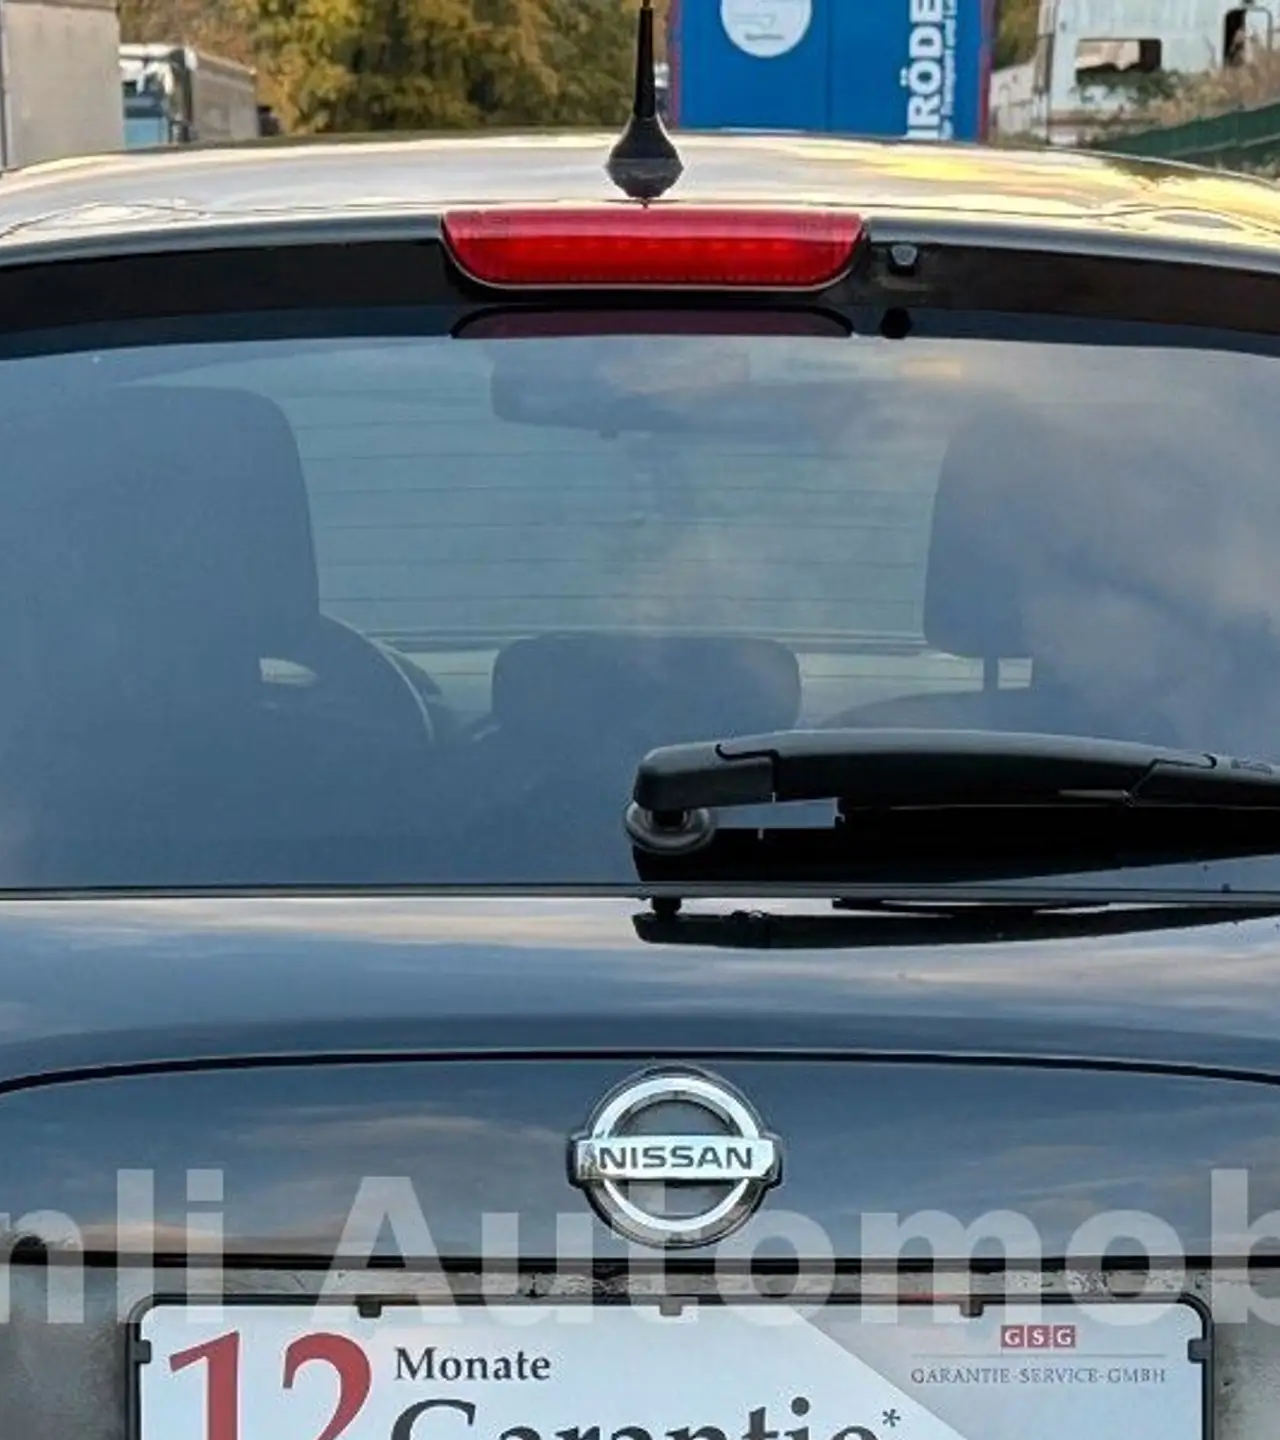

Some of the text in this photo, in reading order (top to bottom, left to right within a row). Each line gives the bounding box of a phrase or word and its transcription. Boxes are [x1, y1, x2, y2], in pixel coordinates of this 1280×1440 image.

[598, 1146, 753, 1170] NISSAN
[1003, 1327, 1073, 1347] GSG
[395, 1346, 552, 1382] Monate
